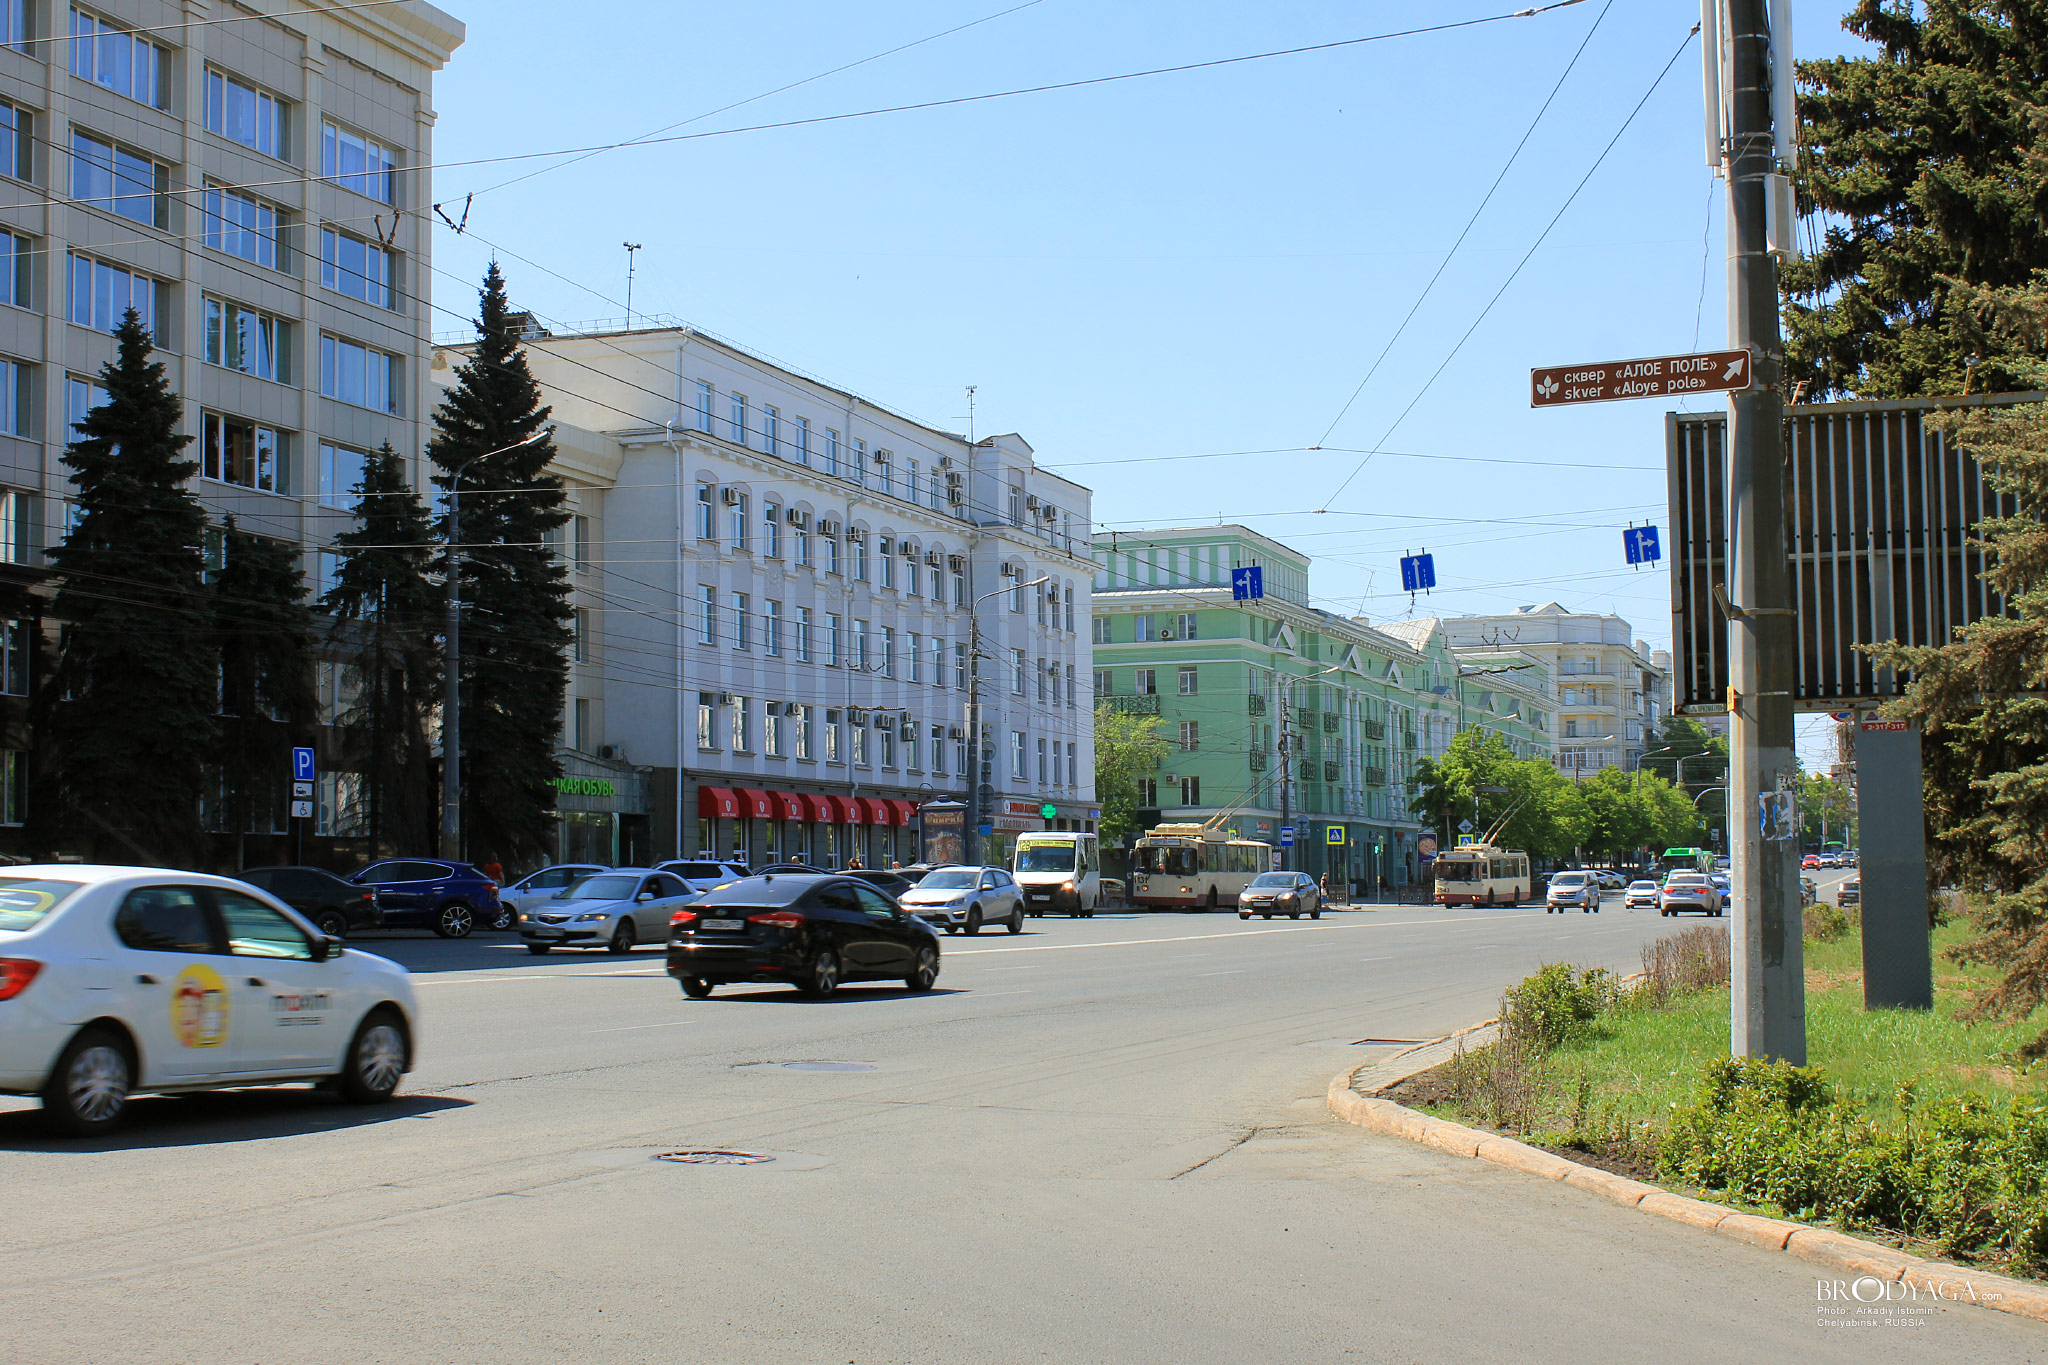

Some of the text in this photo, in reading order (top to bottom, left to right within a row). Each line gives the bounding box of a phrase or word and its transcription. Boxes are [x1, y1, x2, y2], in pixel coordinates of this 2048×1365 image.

[1564, 357, 1717, 384] сквер «АЛОЕ ПОЛЕ»
[1564, 375, 1706, 400] skver «Aloye pole»
[298, 751, 310, 777] P
[582, 779, 616, 797] ОБУВЬ
